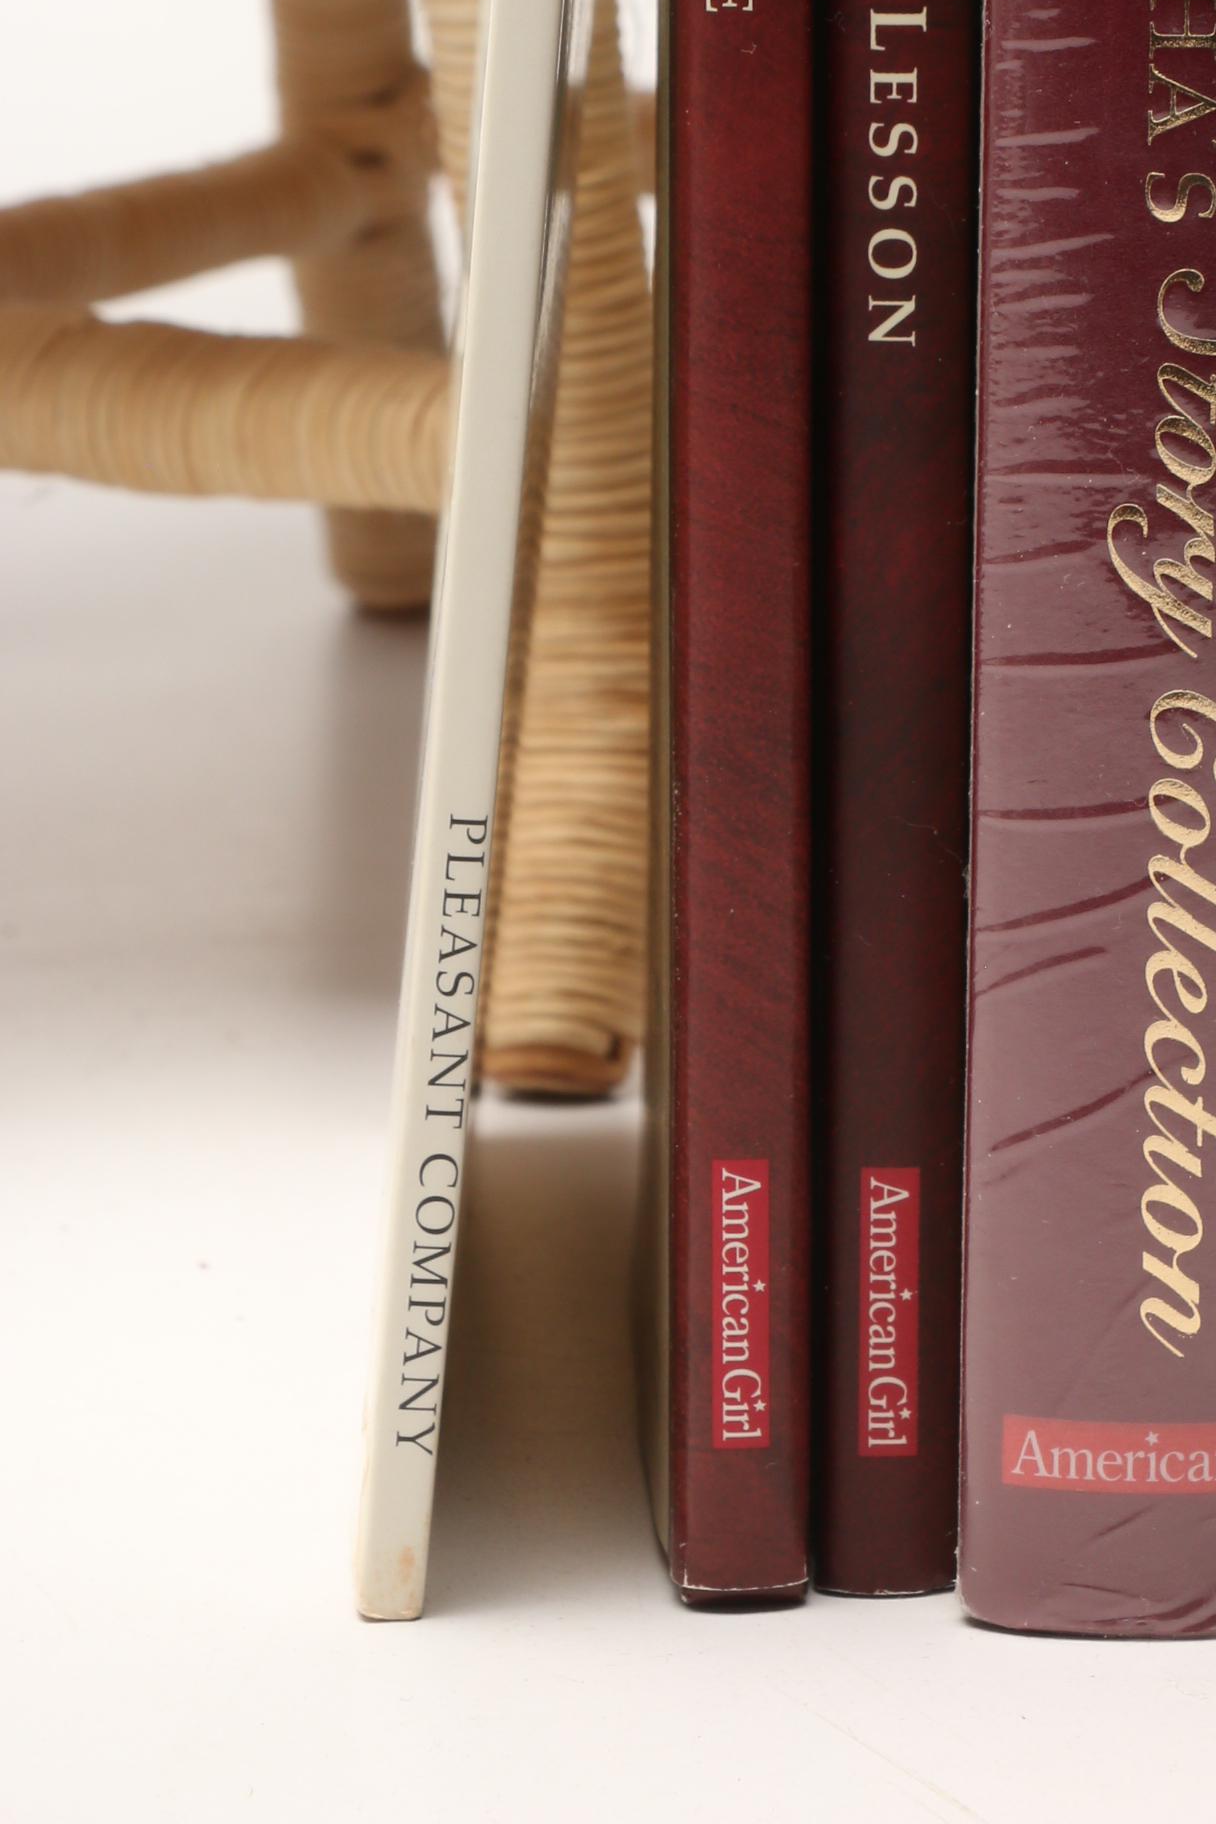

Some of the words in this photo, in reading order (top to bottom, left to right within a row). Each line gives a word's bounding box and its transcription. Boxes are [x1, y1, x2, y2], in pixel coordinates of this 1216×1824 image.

[868, 7, 926, 346] LESSON
[426, 815, 490, 1129] PLEASANT
[397, 1150, 464, 1457] COMPANY
